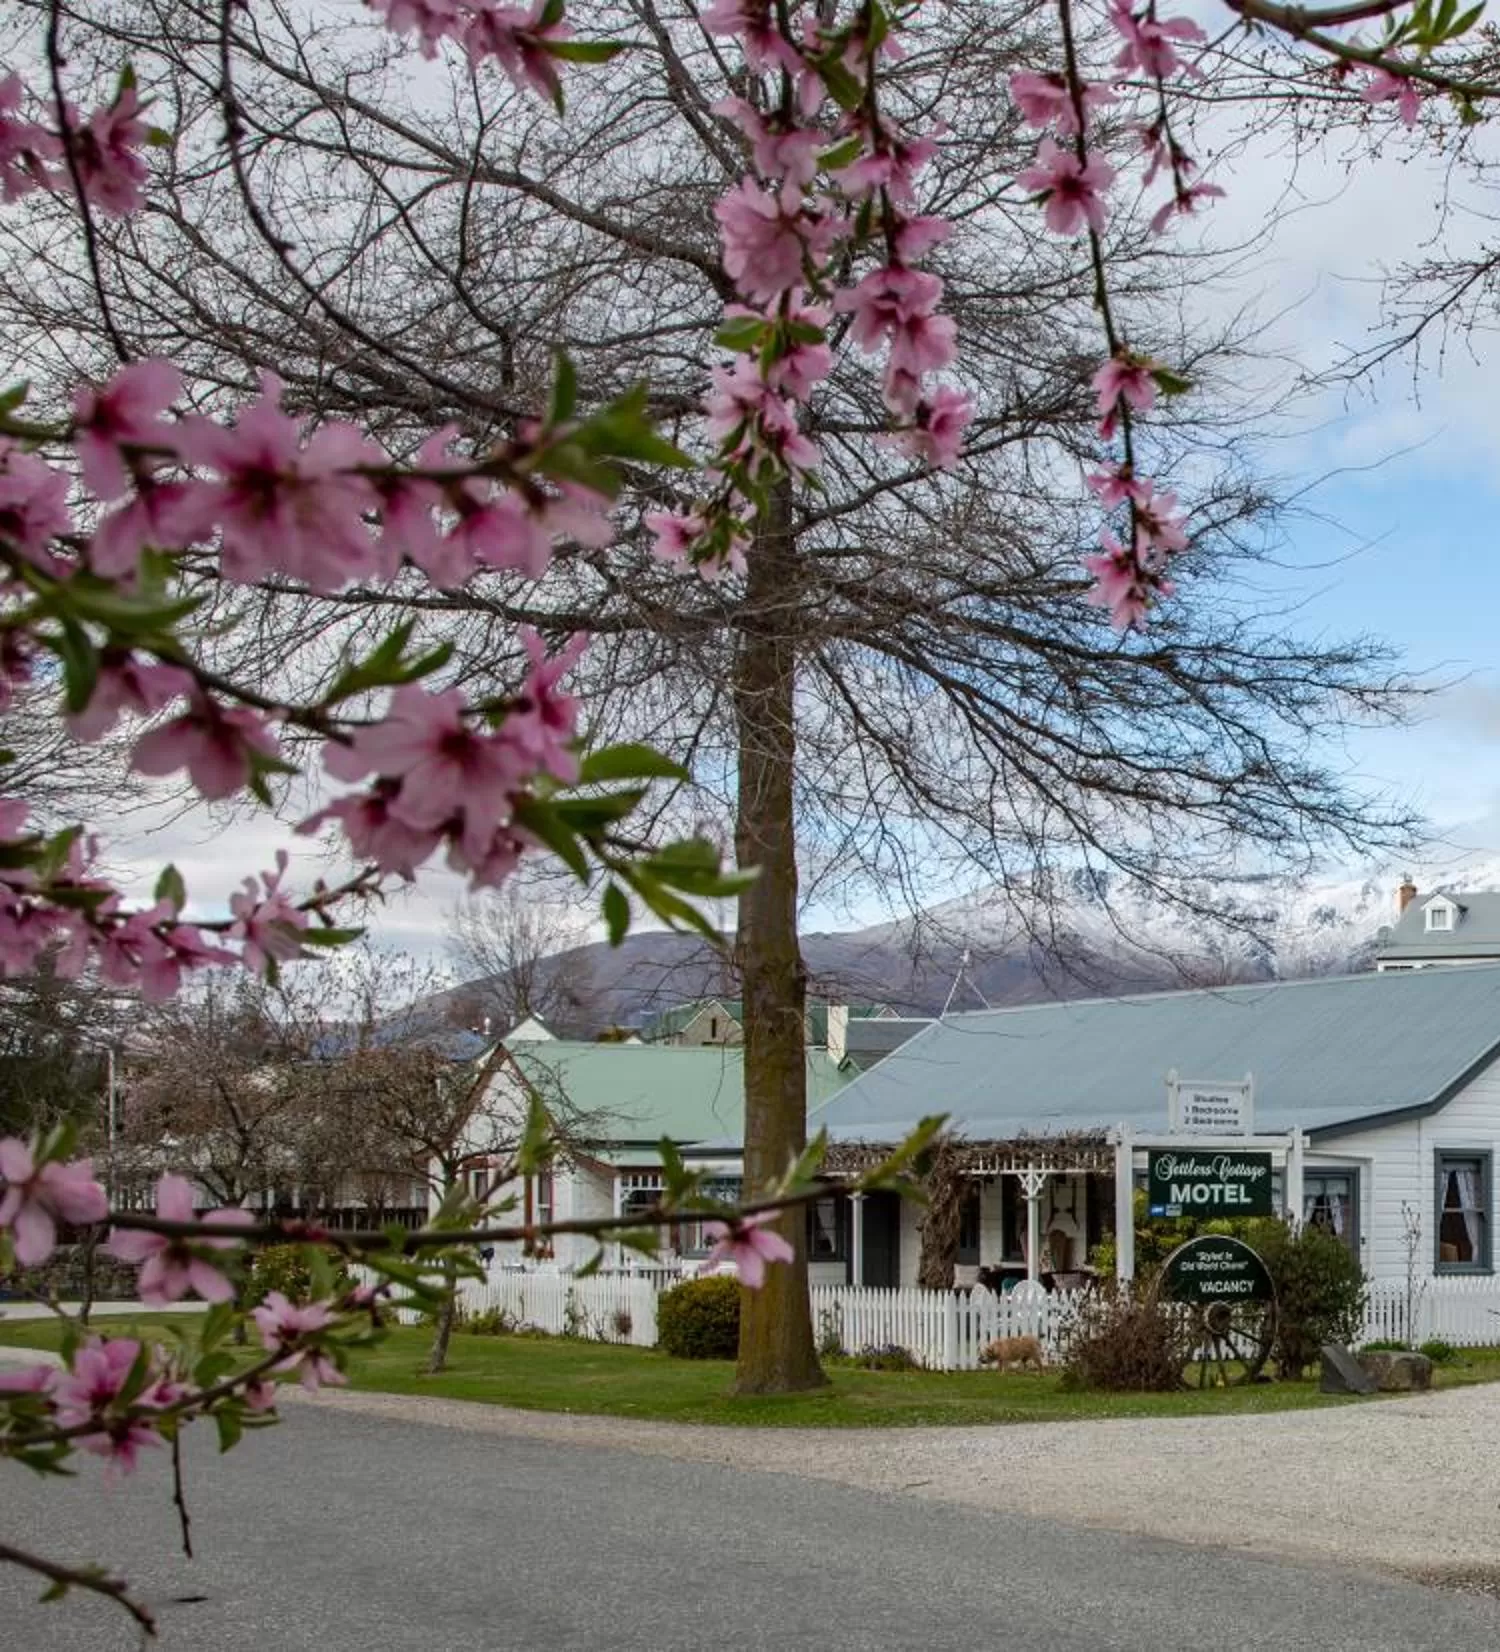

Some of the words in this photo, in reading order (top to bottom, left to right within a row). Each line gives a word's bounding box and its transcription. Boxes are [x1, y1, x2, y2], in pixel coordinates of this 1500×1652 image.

[1155, 1154, 1212, 1181] Settlers
[1211, 1155, 1267, 1182] Cottage
[1170, 1183, 1253, 1204] MOTEL
[1180, 1261, 1195, 1271] Old
[1199, 1280, 1255, 1293] VACANCY
